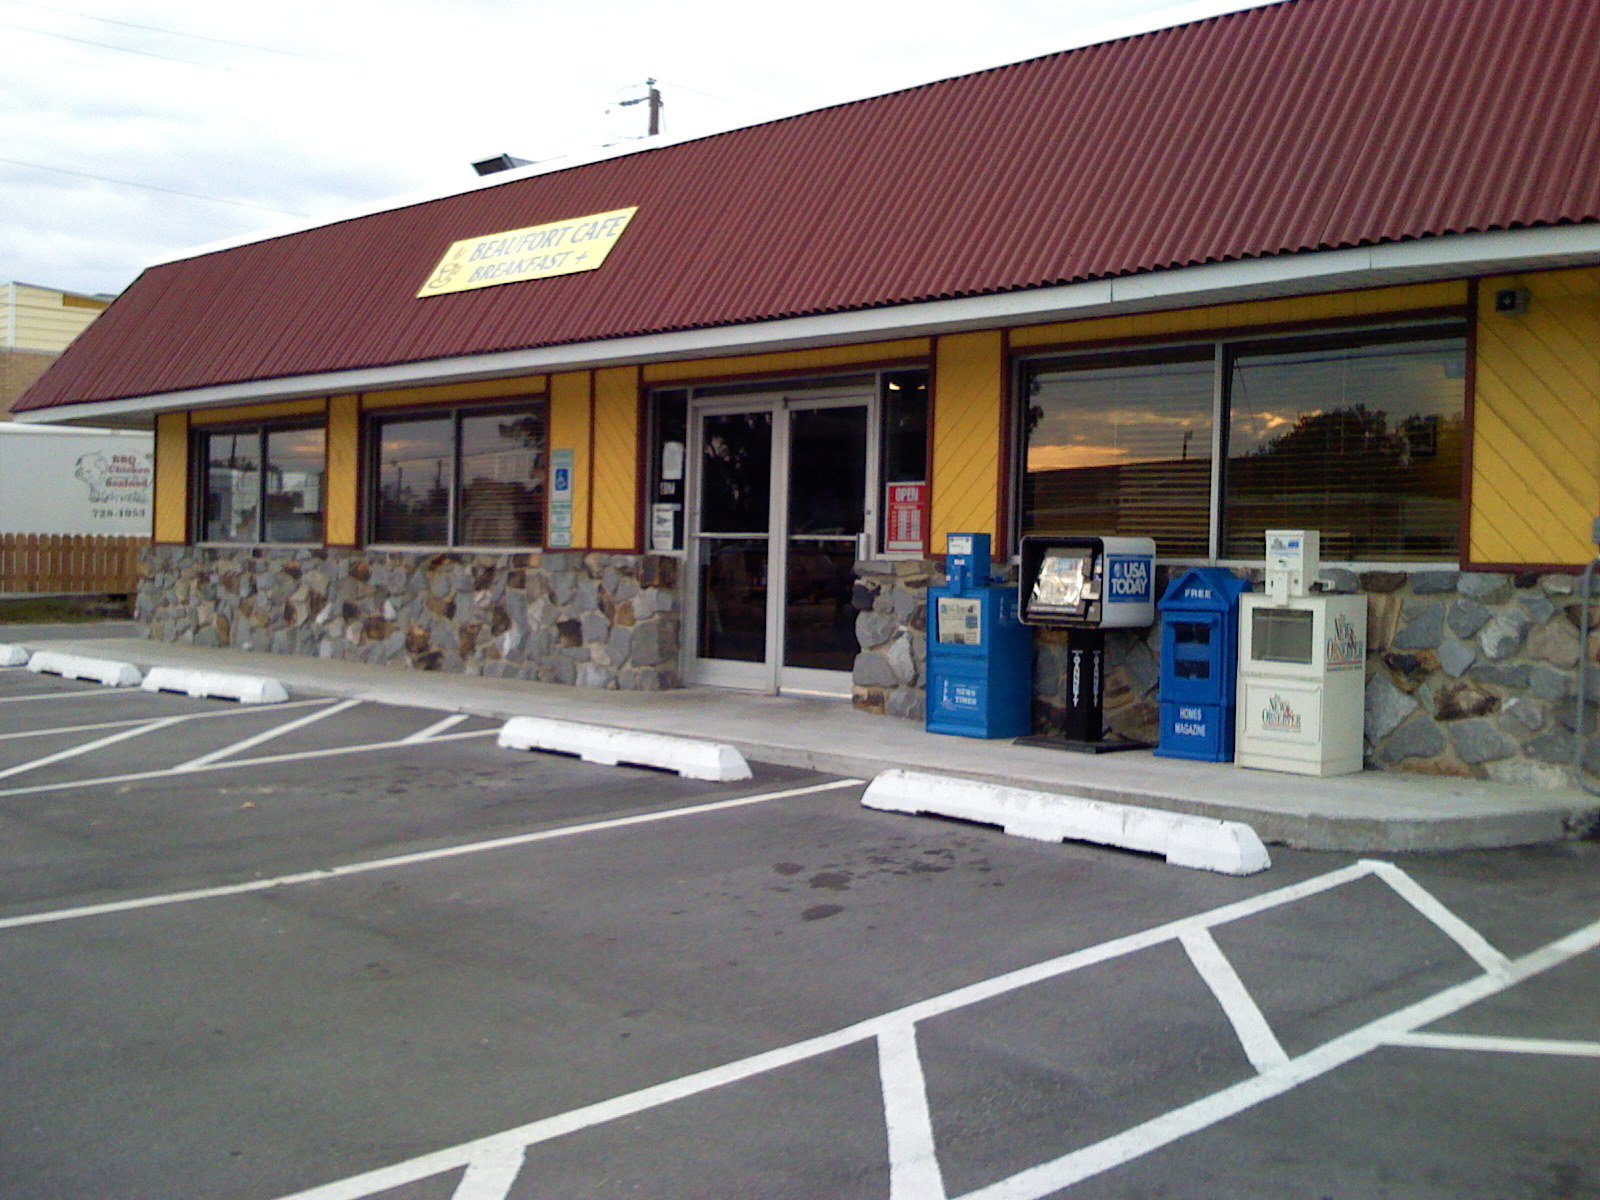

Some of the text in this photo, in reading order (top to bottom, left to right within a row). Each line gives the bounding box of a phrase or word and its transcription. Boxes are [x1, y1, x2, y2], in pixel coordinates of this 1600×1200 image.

[468, 216, 627, 262] BEAUFORT CAFE
[467, 251, 575, 283] BREAKFAST
[112, 455, 136, 467] BBQ
[106, 477, 148, 487] Seafood
[895, 487, 919, 502] OPEN
[1123, 562, 1147, 579] USA
[1111, 576, 1147, 595] TODAY
[1184, 588, 1212, 599] FREE
[955, 687, 976, 697] NEWS
[955, 696, 977, 705] TIMES
[1179, 707, 1202, 720] HOMES
[1175, 722, 1206, 737] MAGAZINE
